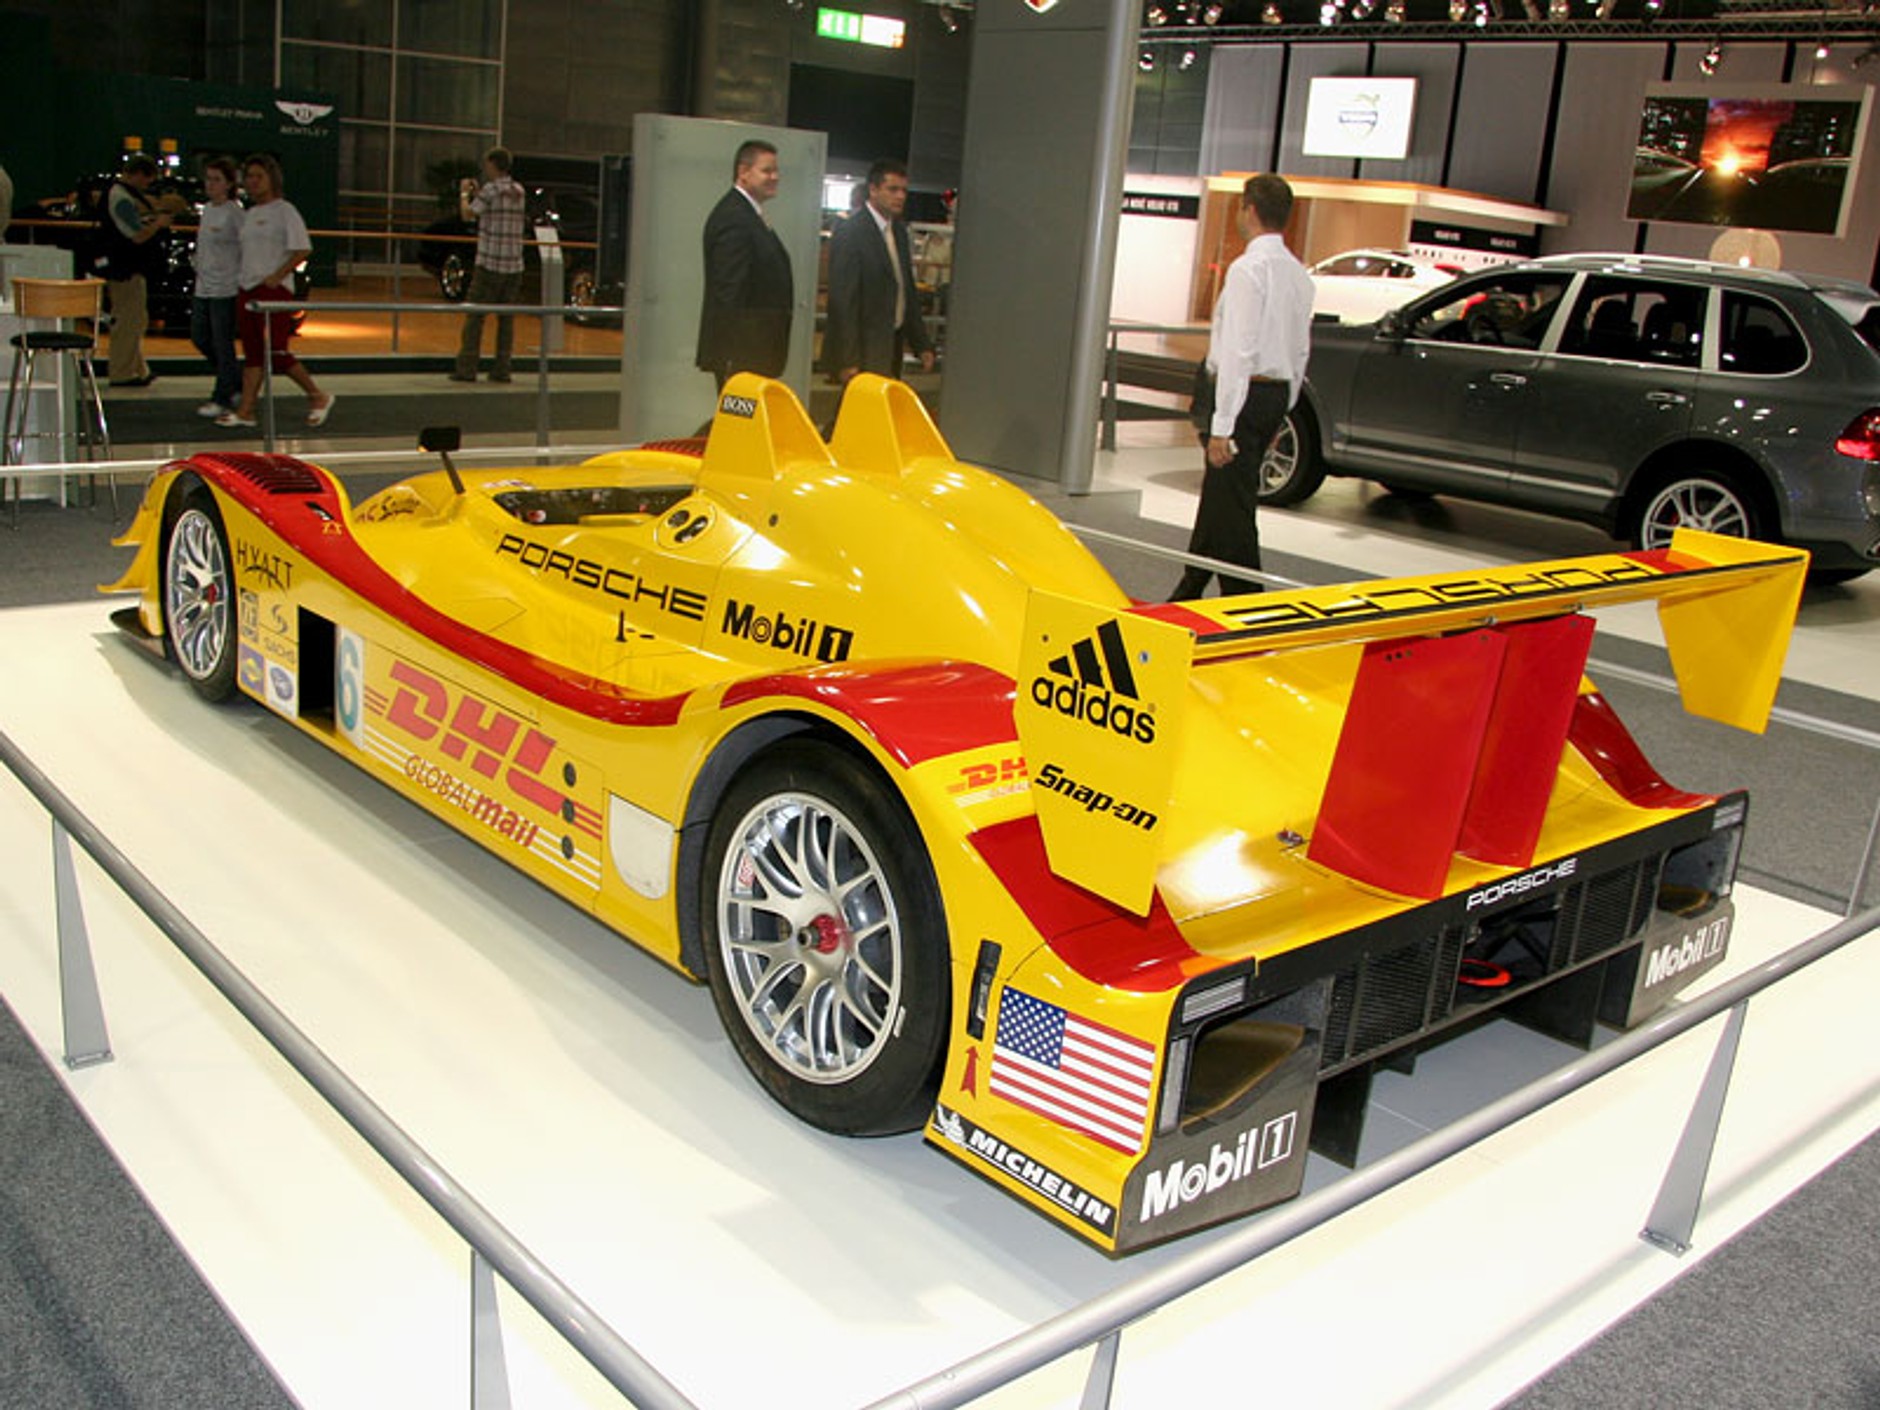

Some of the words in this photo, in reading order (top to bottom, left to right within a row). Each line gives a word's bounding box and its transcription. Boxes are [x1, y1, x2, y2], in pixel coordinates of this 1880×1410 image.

[236, 537, 294, 592] HYATT
[496, 533, 708, 622] PORSCHE
[721, 599, 817, 657] Mobil
[337, 635, 359, 732] 6
[1031, 677, 1156, 744] adidas
[386, 659, 568, 816] DHL
[960, 756, 1029, 789] DH
[1034, 763, 1158, 831] Snap-on
[1466, 857, 1578, 911] PORSCHE
[1645, 926, 1708, 988] Mobil
[969, 1130, 1111, 1225] MICHELIN
[1139, 1128, 1258, 1223] Mobil
